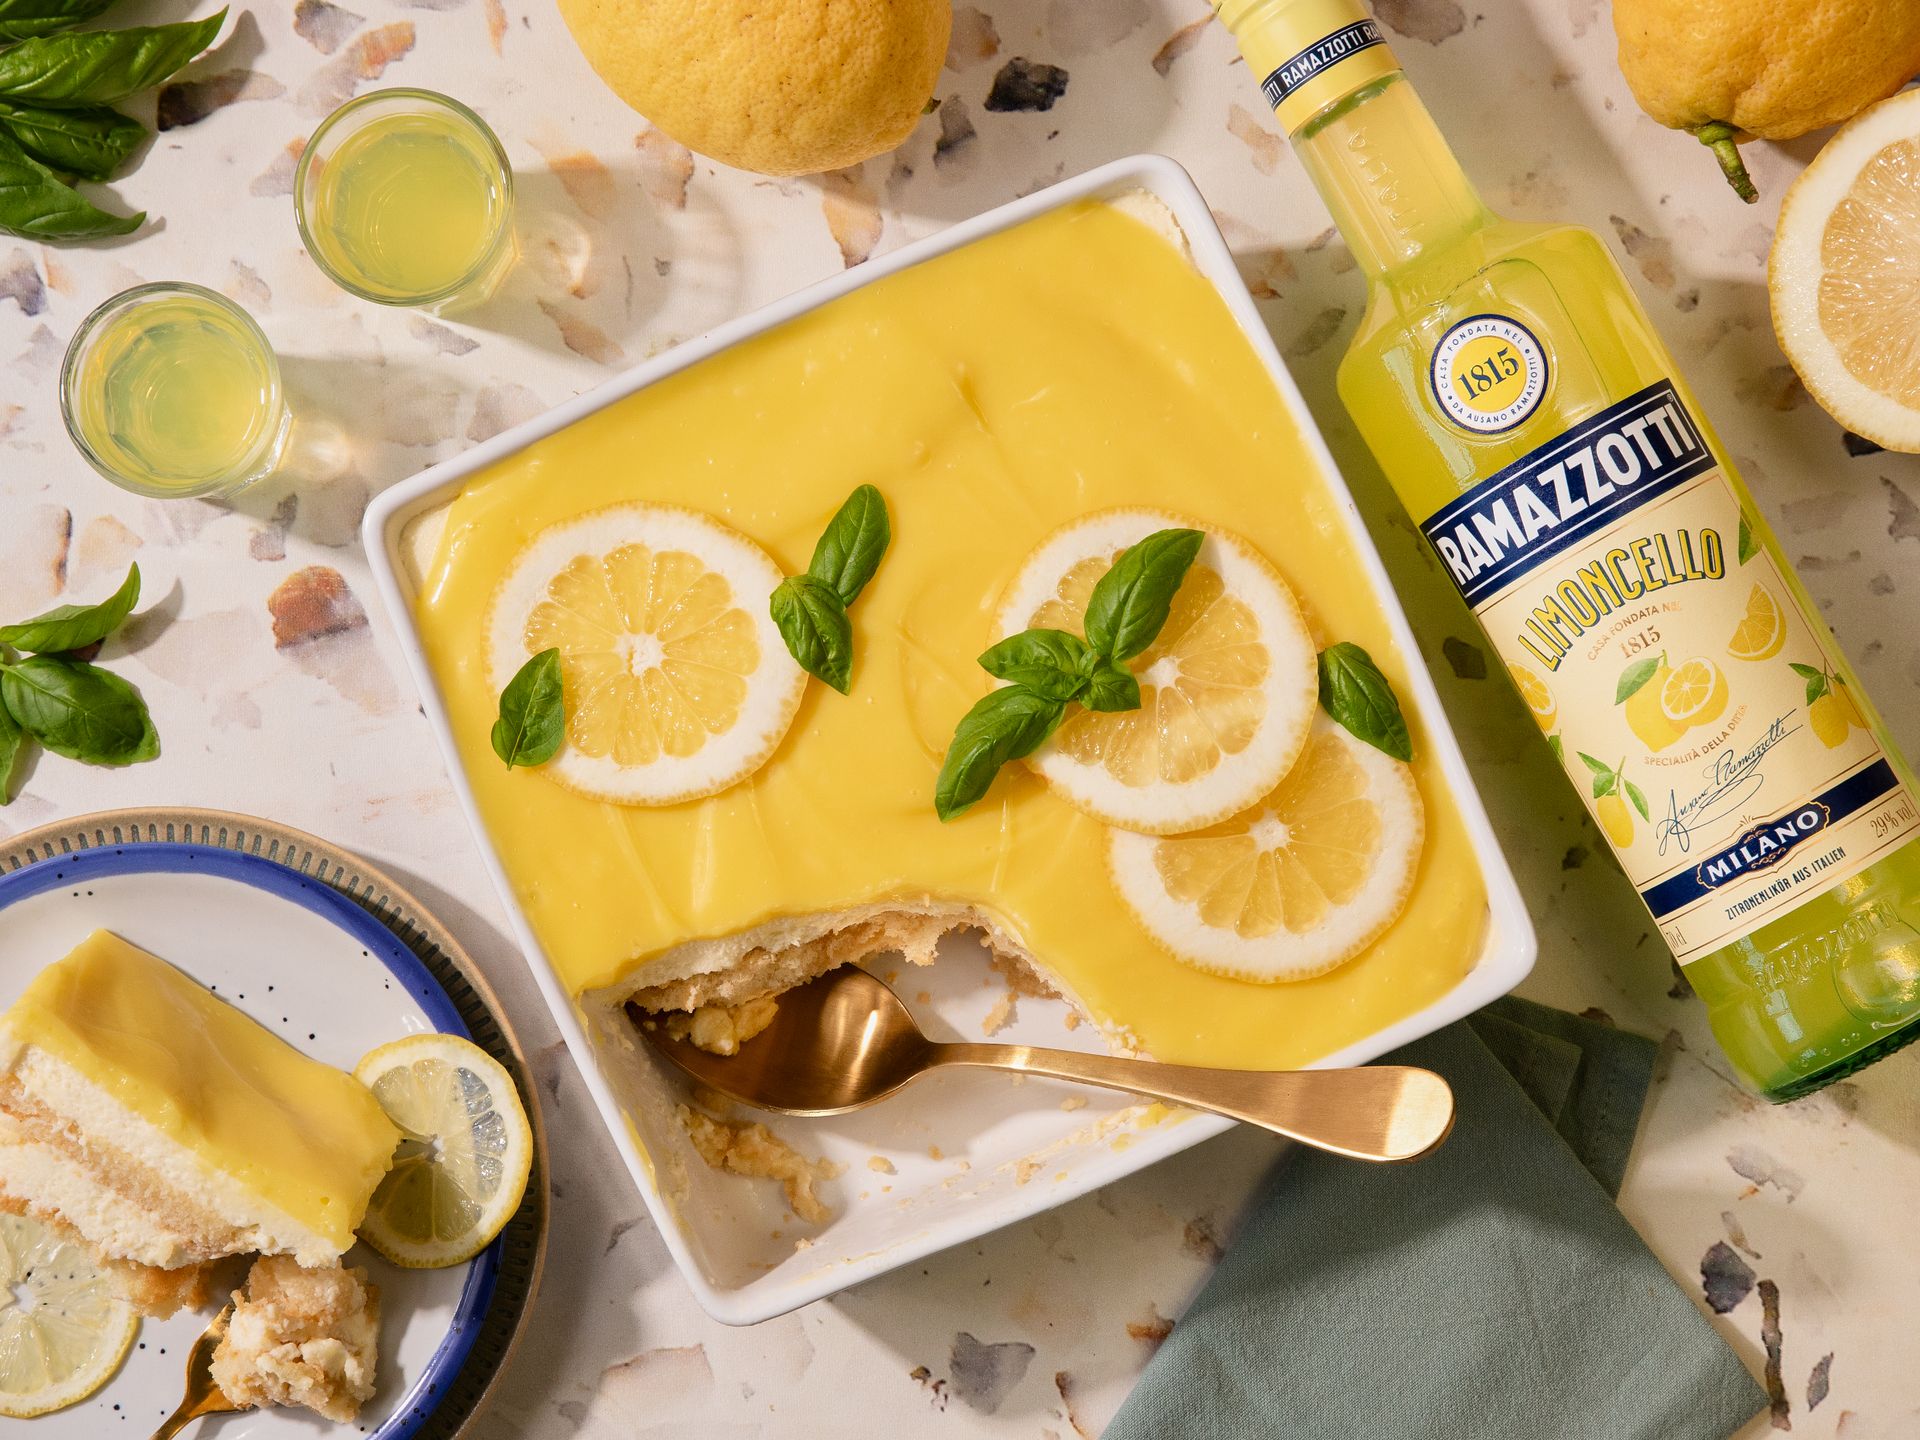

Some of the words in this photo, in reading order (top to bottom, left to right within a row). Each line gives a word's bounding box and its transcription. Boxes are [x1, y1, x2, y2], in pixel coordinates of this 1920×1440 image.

[1281, 29, 1364, 88] RAMAZZOTTI
[1440, 357, 1449, 389] CASA
[1447, 324, 1497, 352] FONDATA
[1504, 328, 1522, 344] NEL
[1458, 347, 1519, 400] 1815
[1452, 402, 1464, 415] DA
[1466, 413, 1508, 424] AUSANO
[1510, 357, 1538, 416] RAMAZZOTTI
[1436, 402, 1697, 586] RAMAZZOTTI
[1518, 528, 1726, 672] LIMONCELLO
[1587, 634, 1611, 661] CASA
[1609, 605, 1660, 636] FONDATA
[1620, 625, 1661, 659] 1815
[1643, 748, 1701, 767] SPECIALITÀ
[1702, 731, 1730, 754] DELLA
[1895, 799, 1916, 822] vol
[1707, 810, 1819, 883] MILANO
[1724, 878, 1792, 921] ZITRONENLIKÖR
[1794, 867, 1812, 885] AUS
[1811, 846, 1847, 873] ITALIEN
